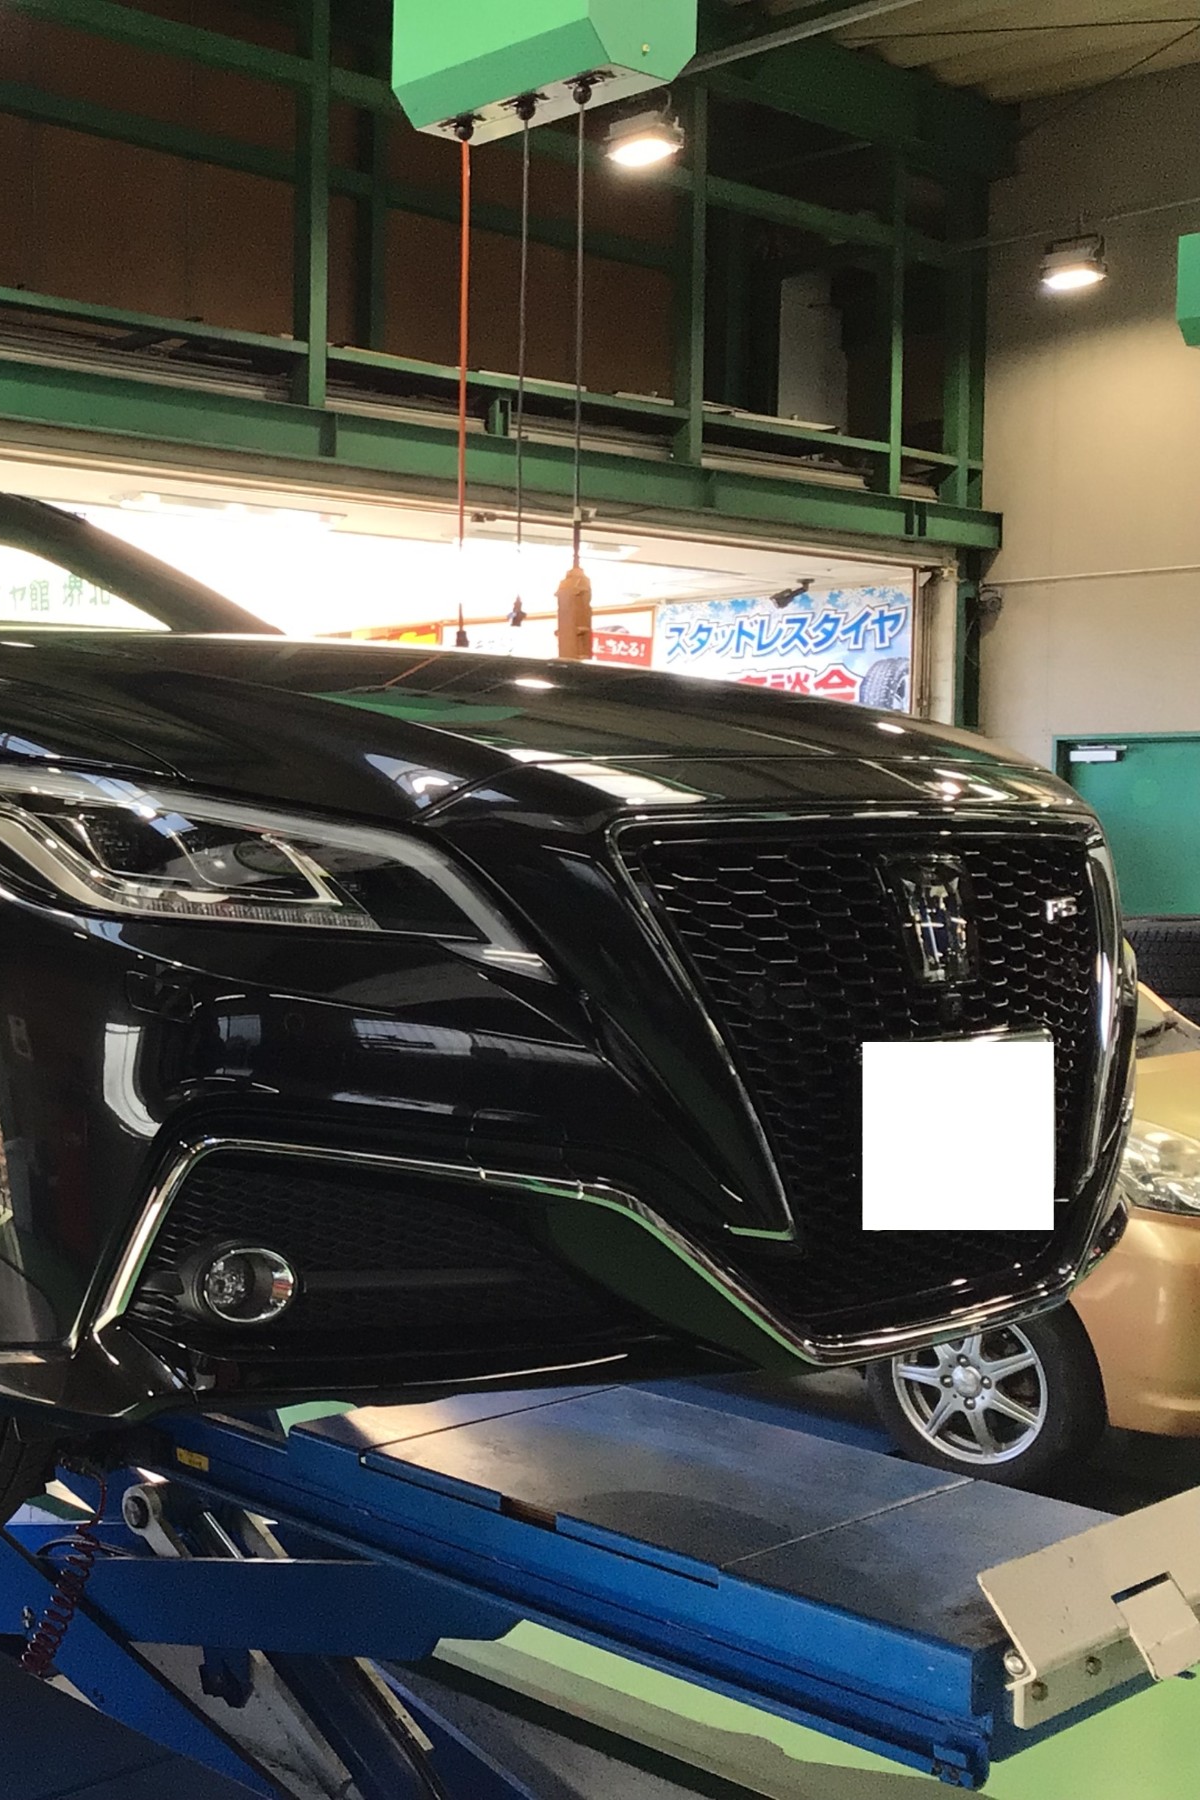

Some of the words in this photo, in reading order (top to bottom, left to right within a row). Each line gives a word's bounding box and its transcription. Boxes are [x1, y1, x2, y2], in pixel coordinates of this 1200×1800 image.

[666, 606, 905, 657] スタッドレスタイヤ
